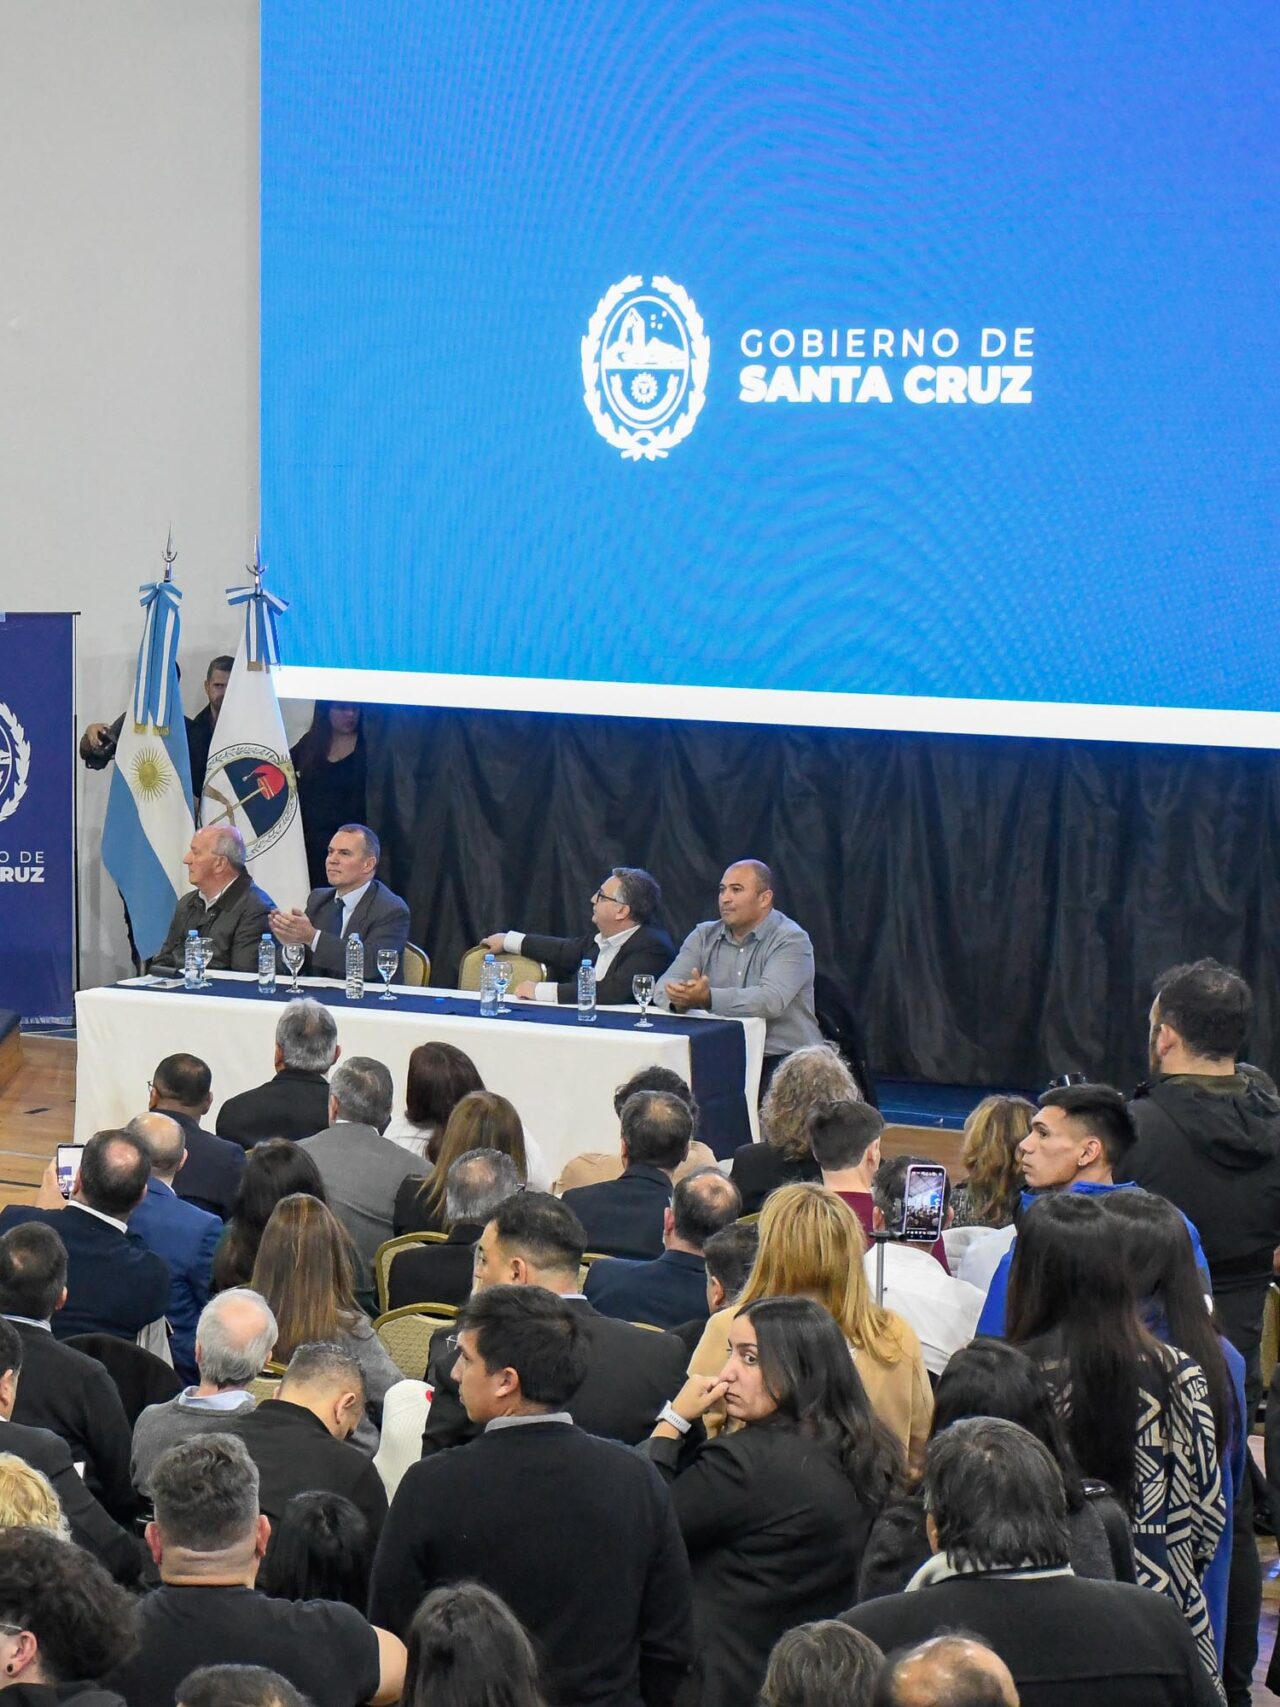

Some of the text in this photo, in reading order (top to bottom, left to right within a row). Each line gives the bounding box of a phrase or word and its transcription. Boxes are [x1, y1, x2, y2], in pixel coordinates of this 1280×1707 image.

[740, 327, 1035, 358] GOBIERNO DE
[739, 365, 1033, 405] SANTA CRUZ
[20, 851, 45, 864] DE
